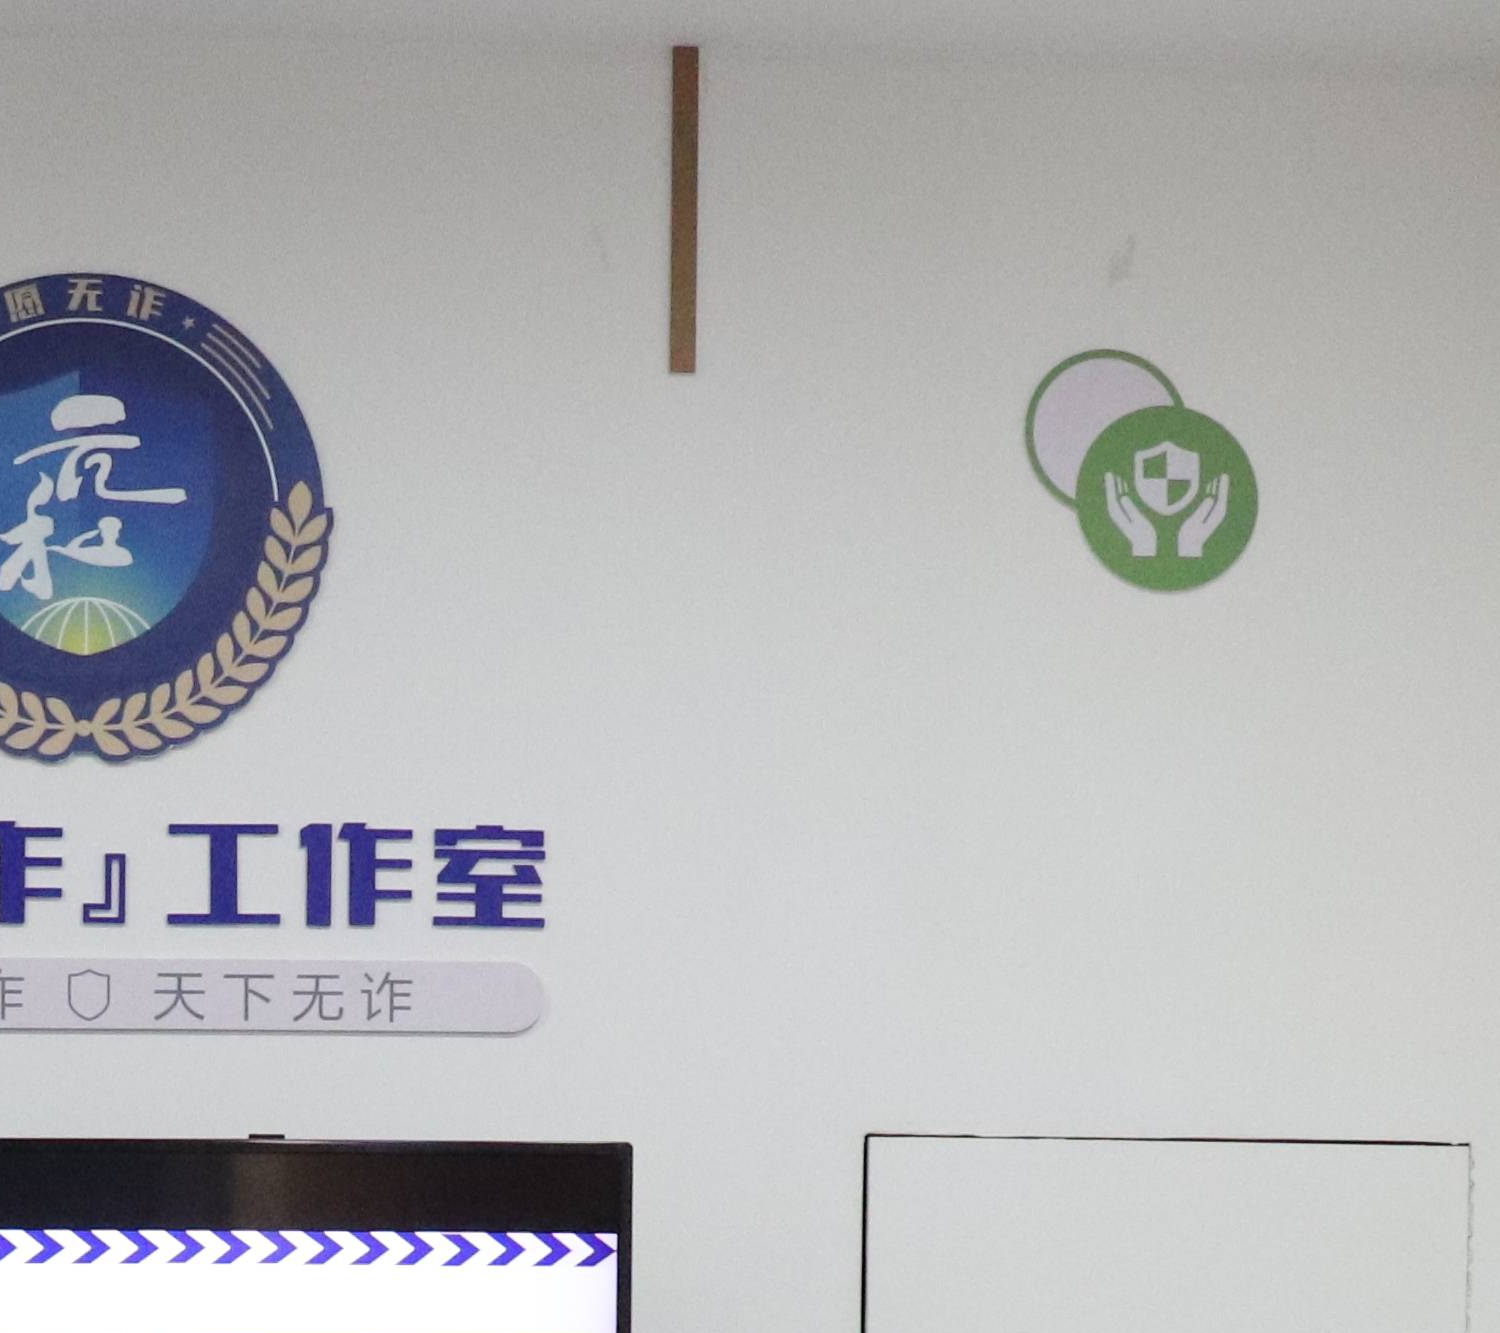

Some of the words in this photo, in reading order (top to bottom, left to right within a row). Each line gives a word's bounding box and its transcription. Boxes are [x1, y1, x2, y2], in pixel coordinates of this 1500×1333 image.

[3, 277, 167, 323] 愿无诈
[153, 969, 415, 1025] 天下无诈
